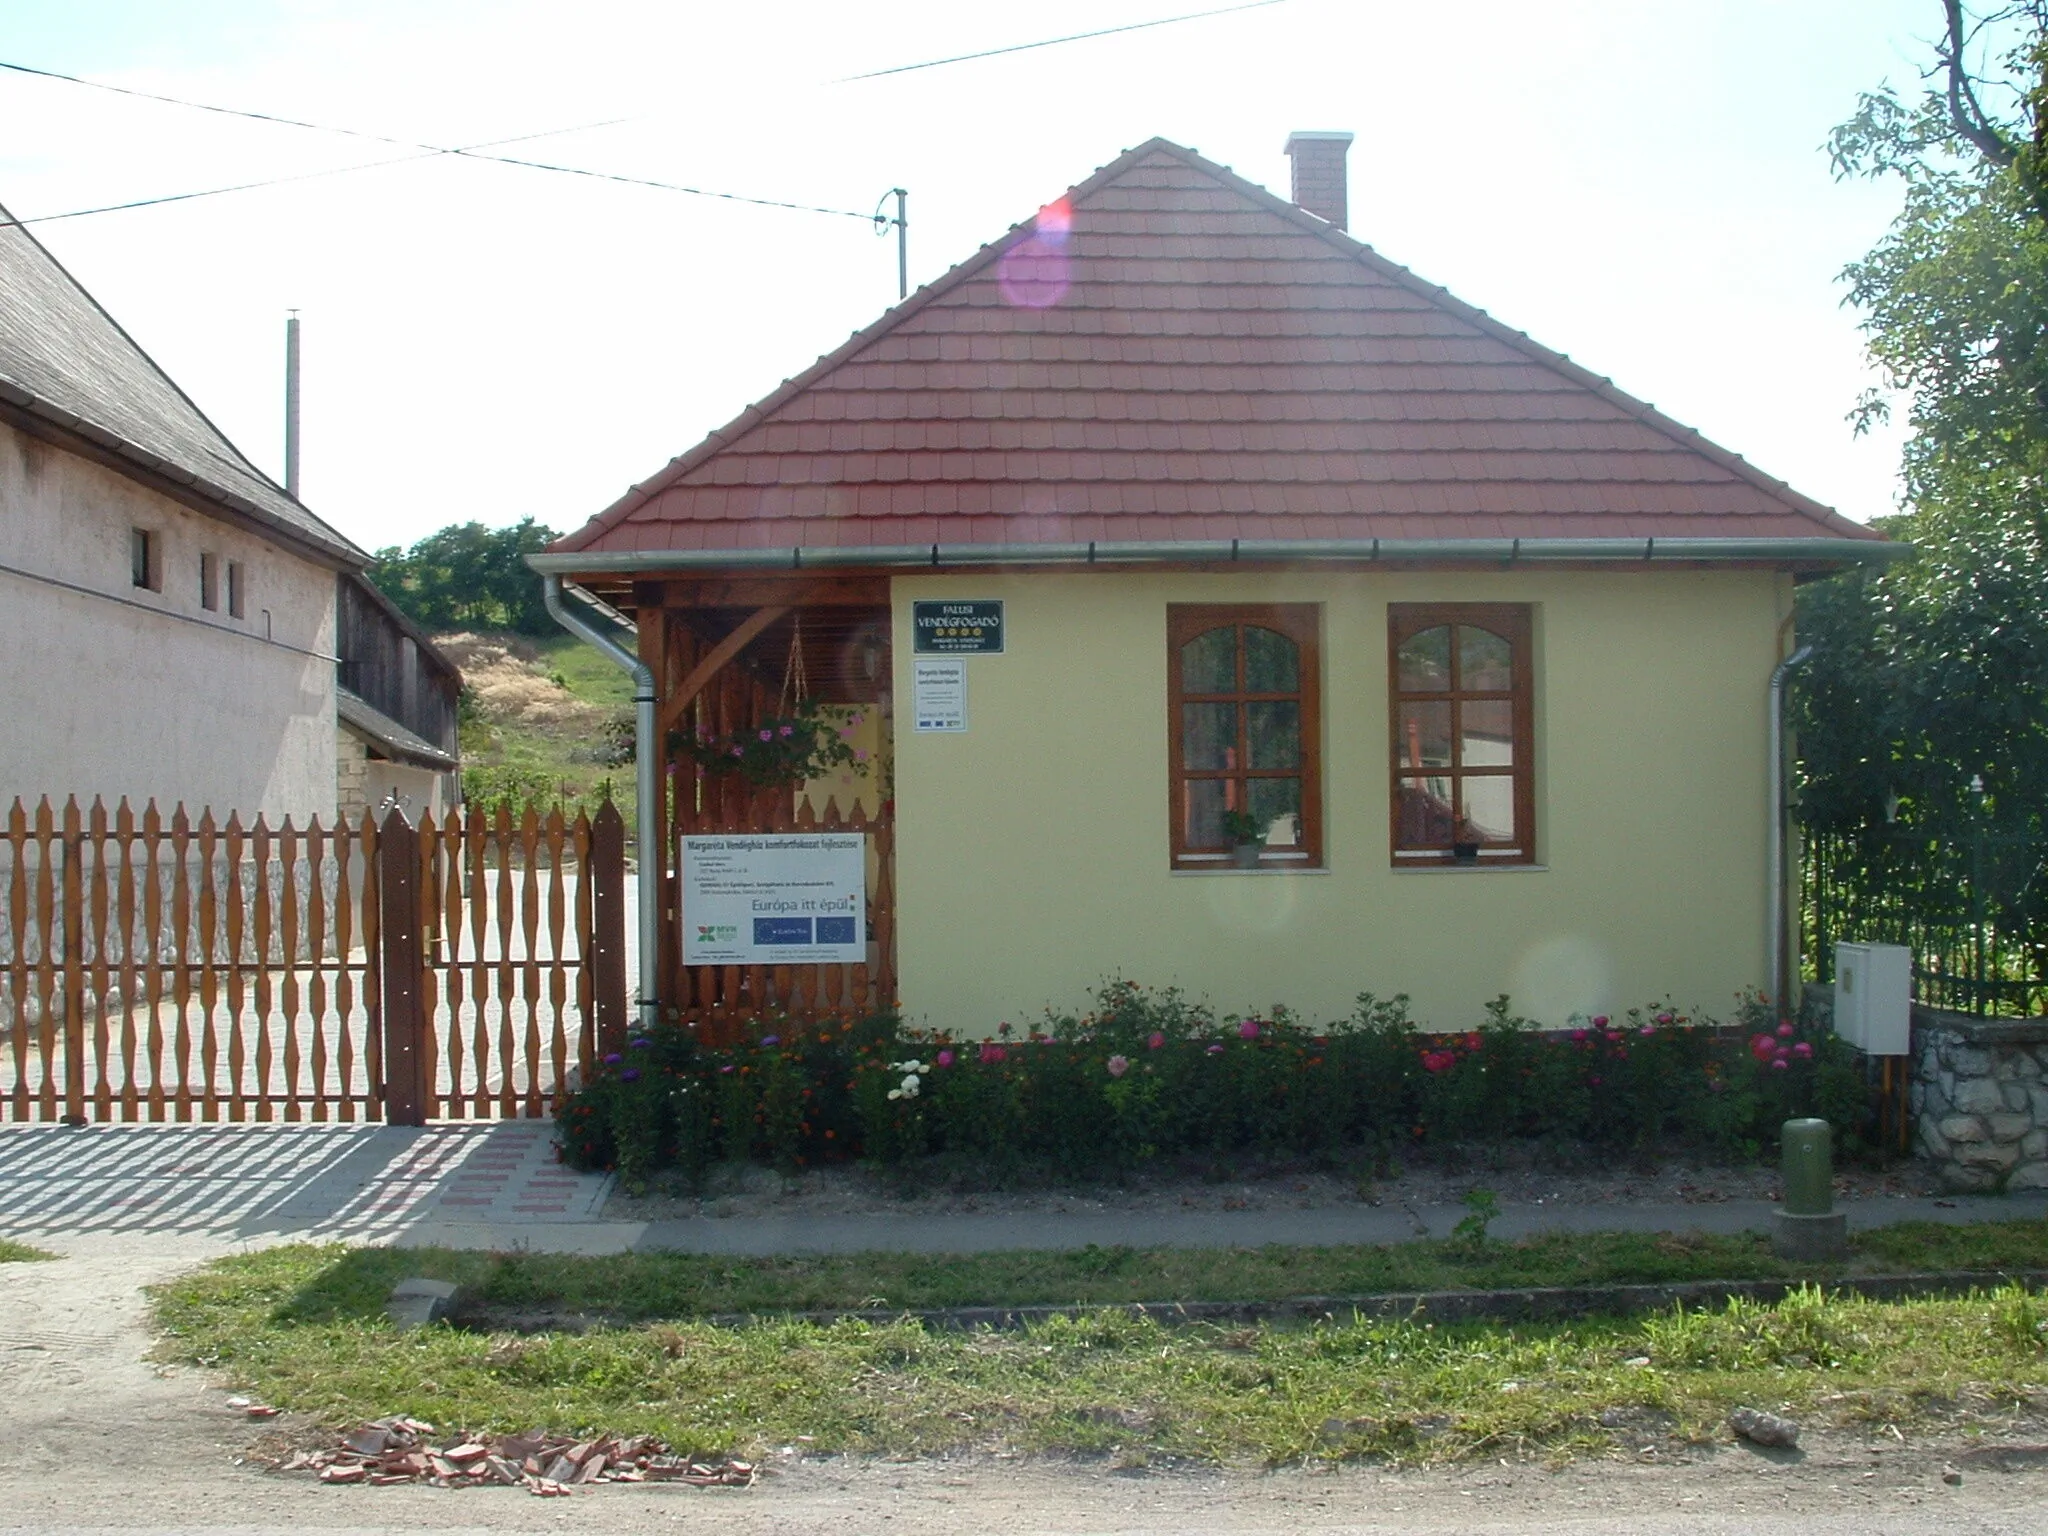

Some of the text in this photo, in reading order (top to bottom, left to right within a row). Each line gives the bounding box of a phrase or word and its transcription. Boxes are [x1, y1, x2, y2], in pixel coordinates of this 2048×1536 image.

[918, 614, 999, 627] VENDÉGFOGADÓ
[751, 898, 798, 914] Európa
[801, 898, 816, 911] itt
